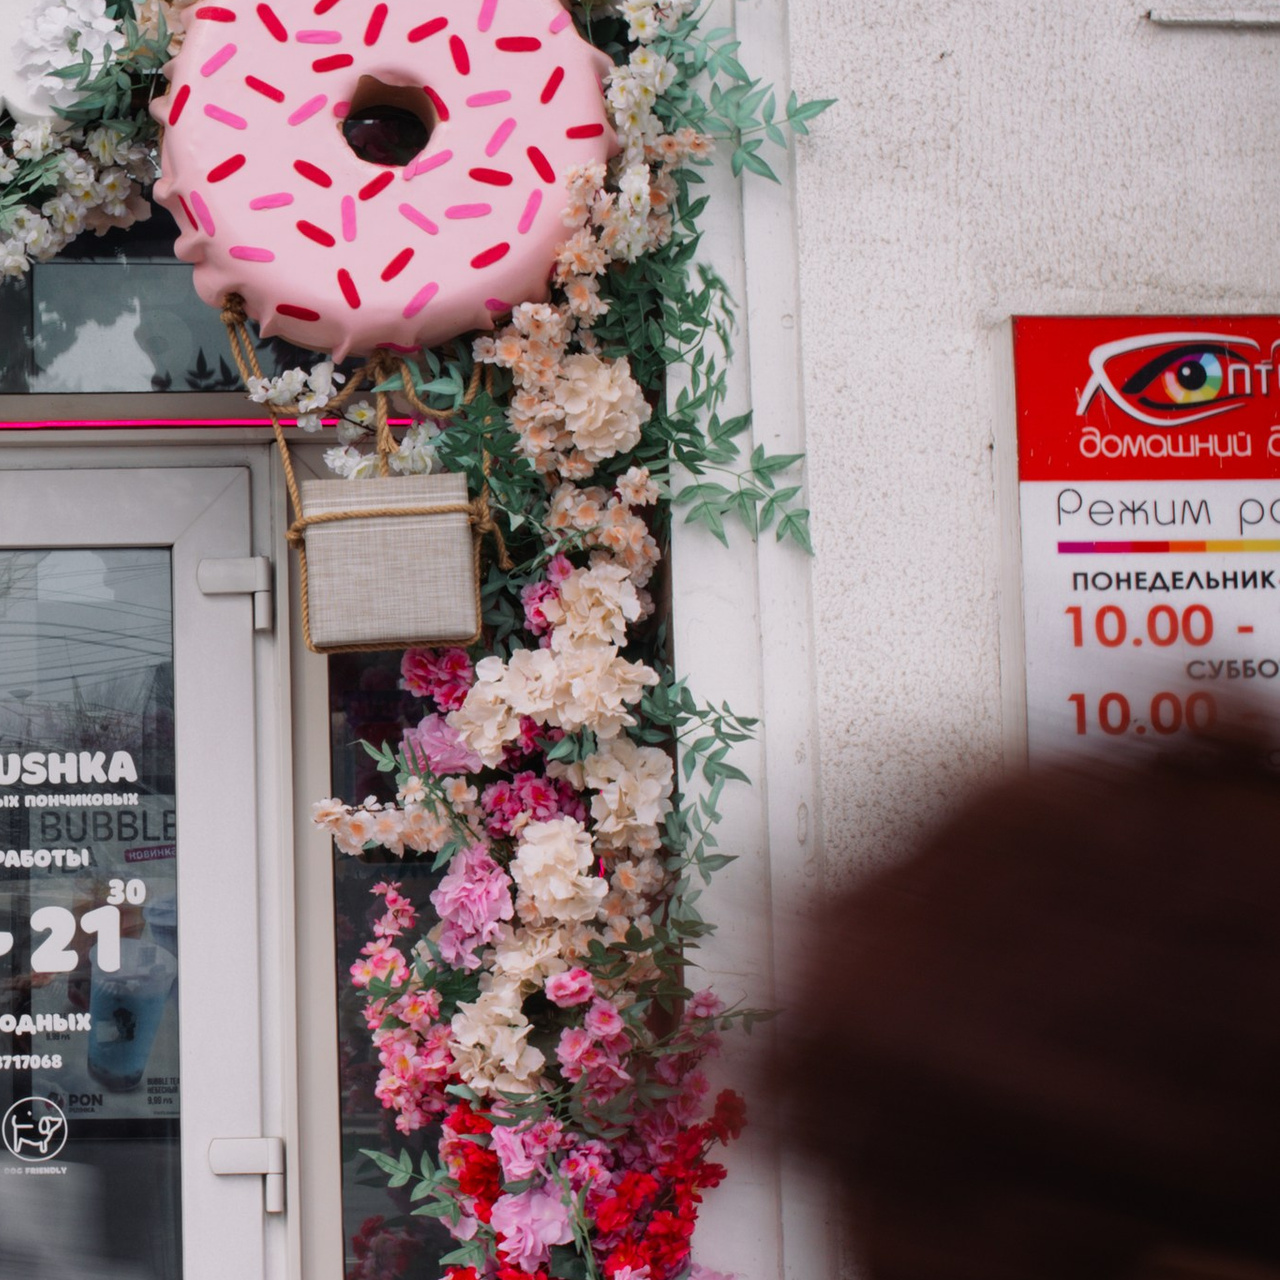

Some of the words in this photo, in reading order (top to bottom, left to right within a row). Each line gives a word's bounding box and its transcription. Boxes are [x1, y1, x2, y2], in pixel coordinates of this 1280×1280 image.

[1079, 426, 1252, 458] домашний
[1057, 488, 1212, 526] Режим
[1064, 604, 1214, 648] 10.00
[1067, 691, 1218, 737] 10.00
[24, 793, 138, 807] ПОНЧИКОВЫХ
[106, 878, 146, 905] 30
[30, 905, 121, 973] 21
[69, 1094, 103, 1106] PON
[25, 1166, 67, 1175] FRIENDLY
